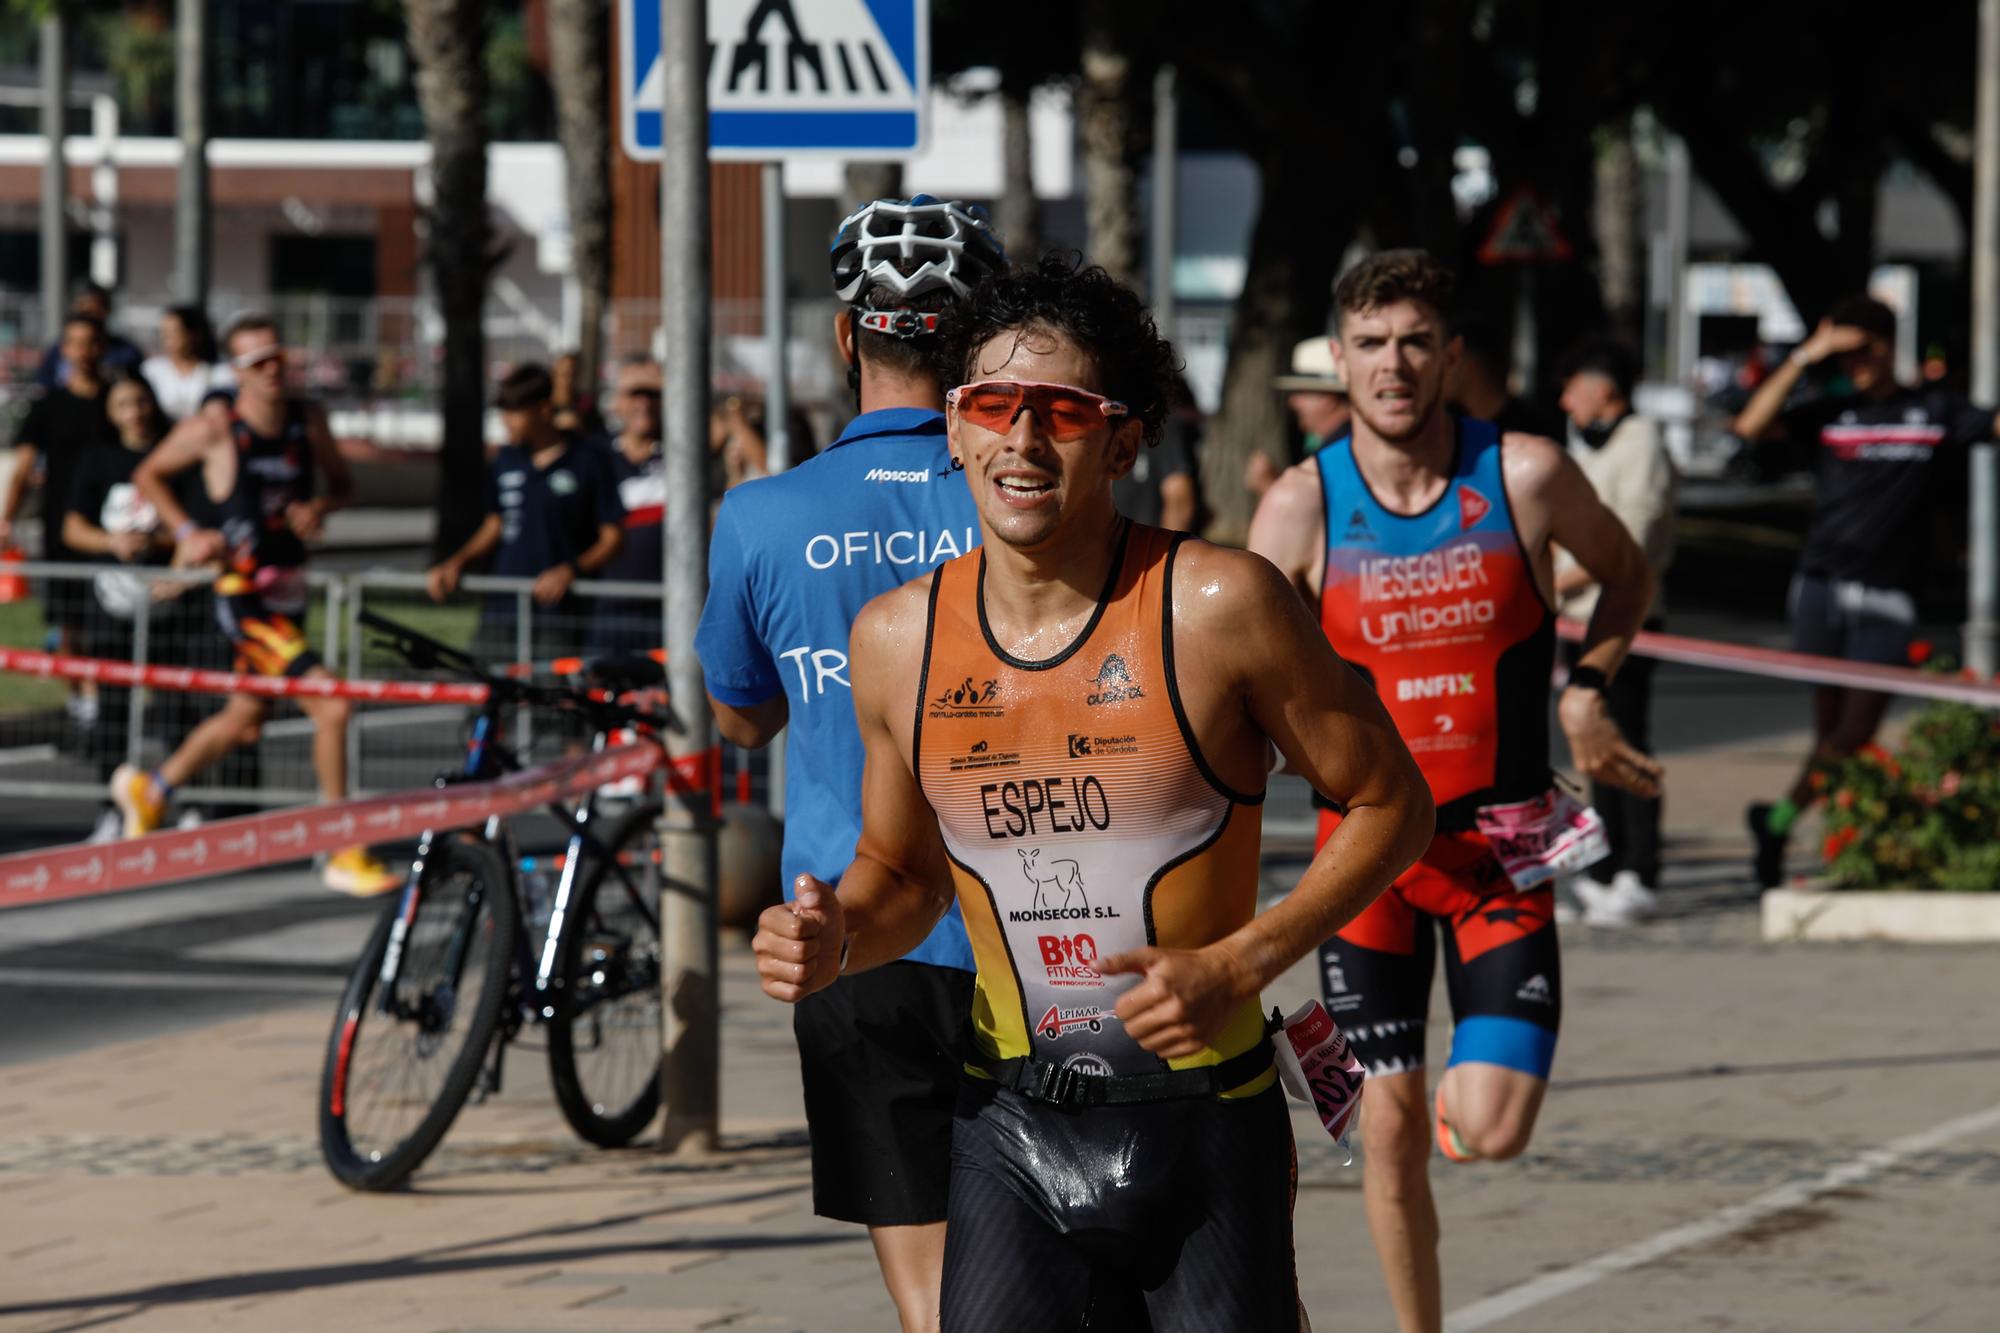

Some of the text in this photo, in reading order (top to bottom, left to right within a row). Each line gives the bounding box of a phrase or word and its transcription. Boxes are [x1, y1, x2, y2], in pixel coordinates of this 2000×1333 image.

[864, 468, 929, 482] Mosconi
[1359, 543, 1488, 603] MESEGUER
[779, 646, 852, 704] TR
[1396, 672, 1476, 702] BNFIX
[1094, 735, 1136, 747] Diputación
[981, 775, 1110, 839] ESPEJO
[1009, 906, 1121, 922] MONSECOR S.L.
[1046, 966, 1101, 979] FITNESS
